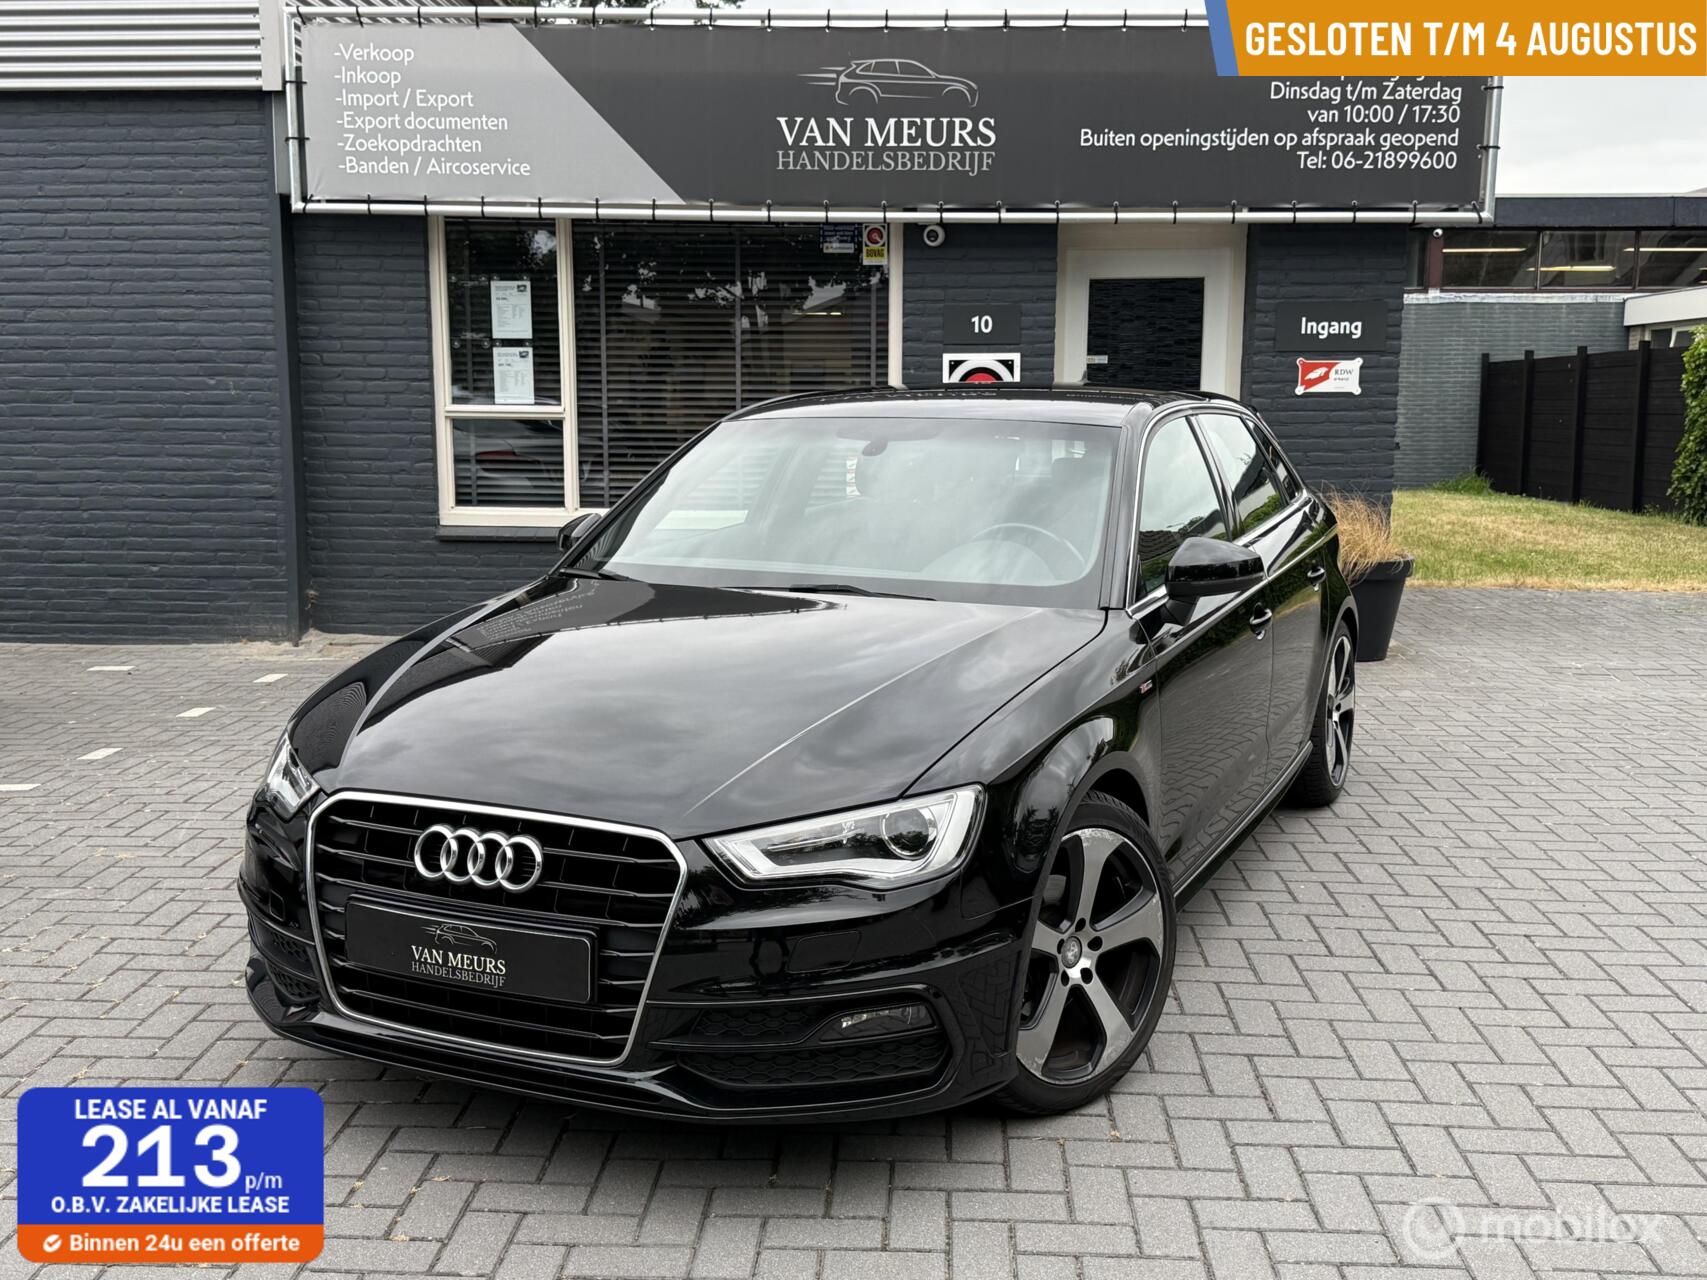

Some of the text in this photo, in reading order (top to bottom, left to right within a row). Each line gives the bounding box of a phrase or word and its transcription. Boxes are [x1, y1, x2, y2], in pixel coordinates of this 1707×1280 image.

[334, 43, 414, 65] -Verkoop
[333, 66, 401, 86] -Inkoop
[336, 89, 399, 110] -Import
[416, 89, 473, 111] Export
[1271, 81, 1461, 105] Dinsdag t/m Zaterdag
[337, 112, 507, 133] -Export documenten
[1308, 110, 1338, 122] van
[1344, 105, 1393, 122] 10:00
[1413, 105, 1460, 123] 17:30
[777, 117, 995, 146] VAN MEURS
[1081, 128, 1458, 150] Buiten openingstijden op afspraak geopend
[337, 134, 481, 156] -Zoekopdrachten
[339, 157, 408, 173] -Banden
[427, 158, 530, 175] Aircoservice
[777, 151, 995, 176] HANDELSBEDRIJF
[1297, 151, 1457, 169] Tel: 06-21899600
[972, 316, 992, 333] 10
[1302, 317, 1361, 338] Ingang
[1334, 368, 1354, 376] RDW
[411, 945, 506, 975] VAN MEURS
[411, 961, 506, 989] HANDELSBEDRIJF
